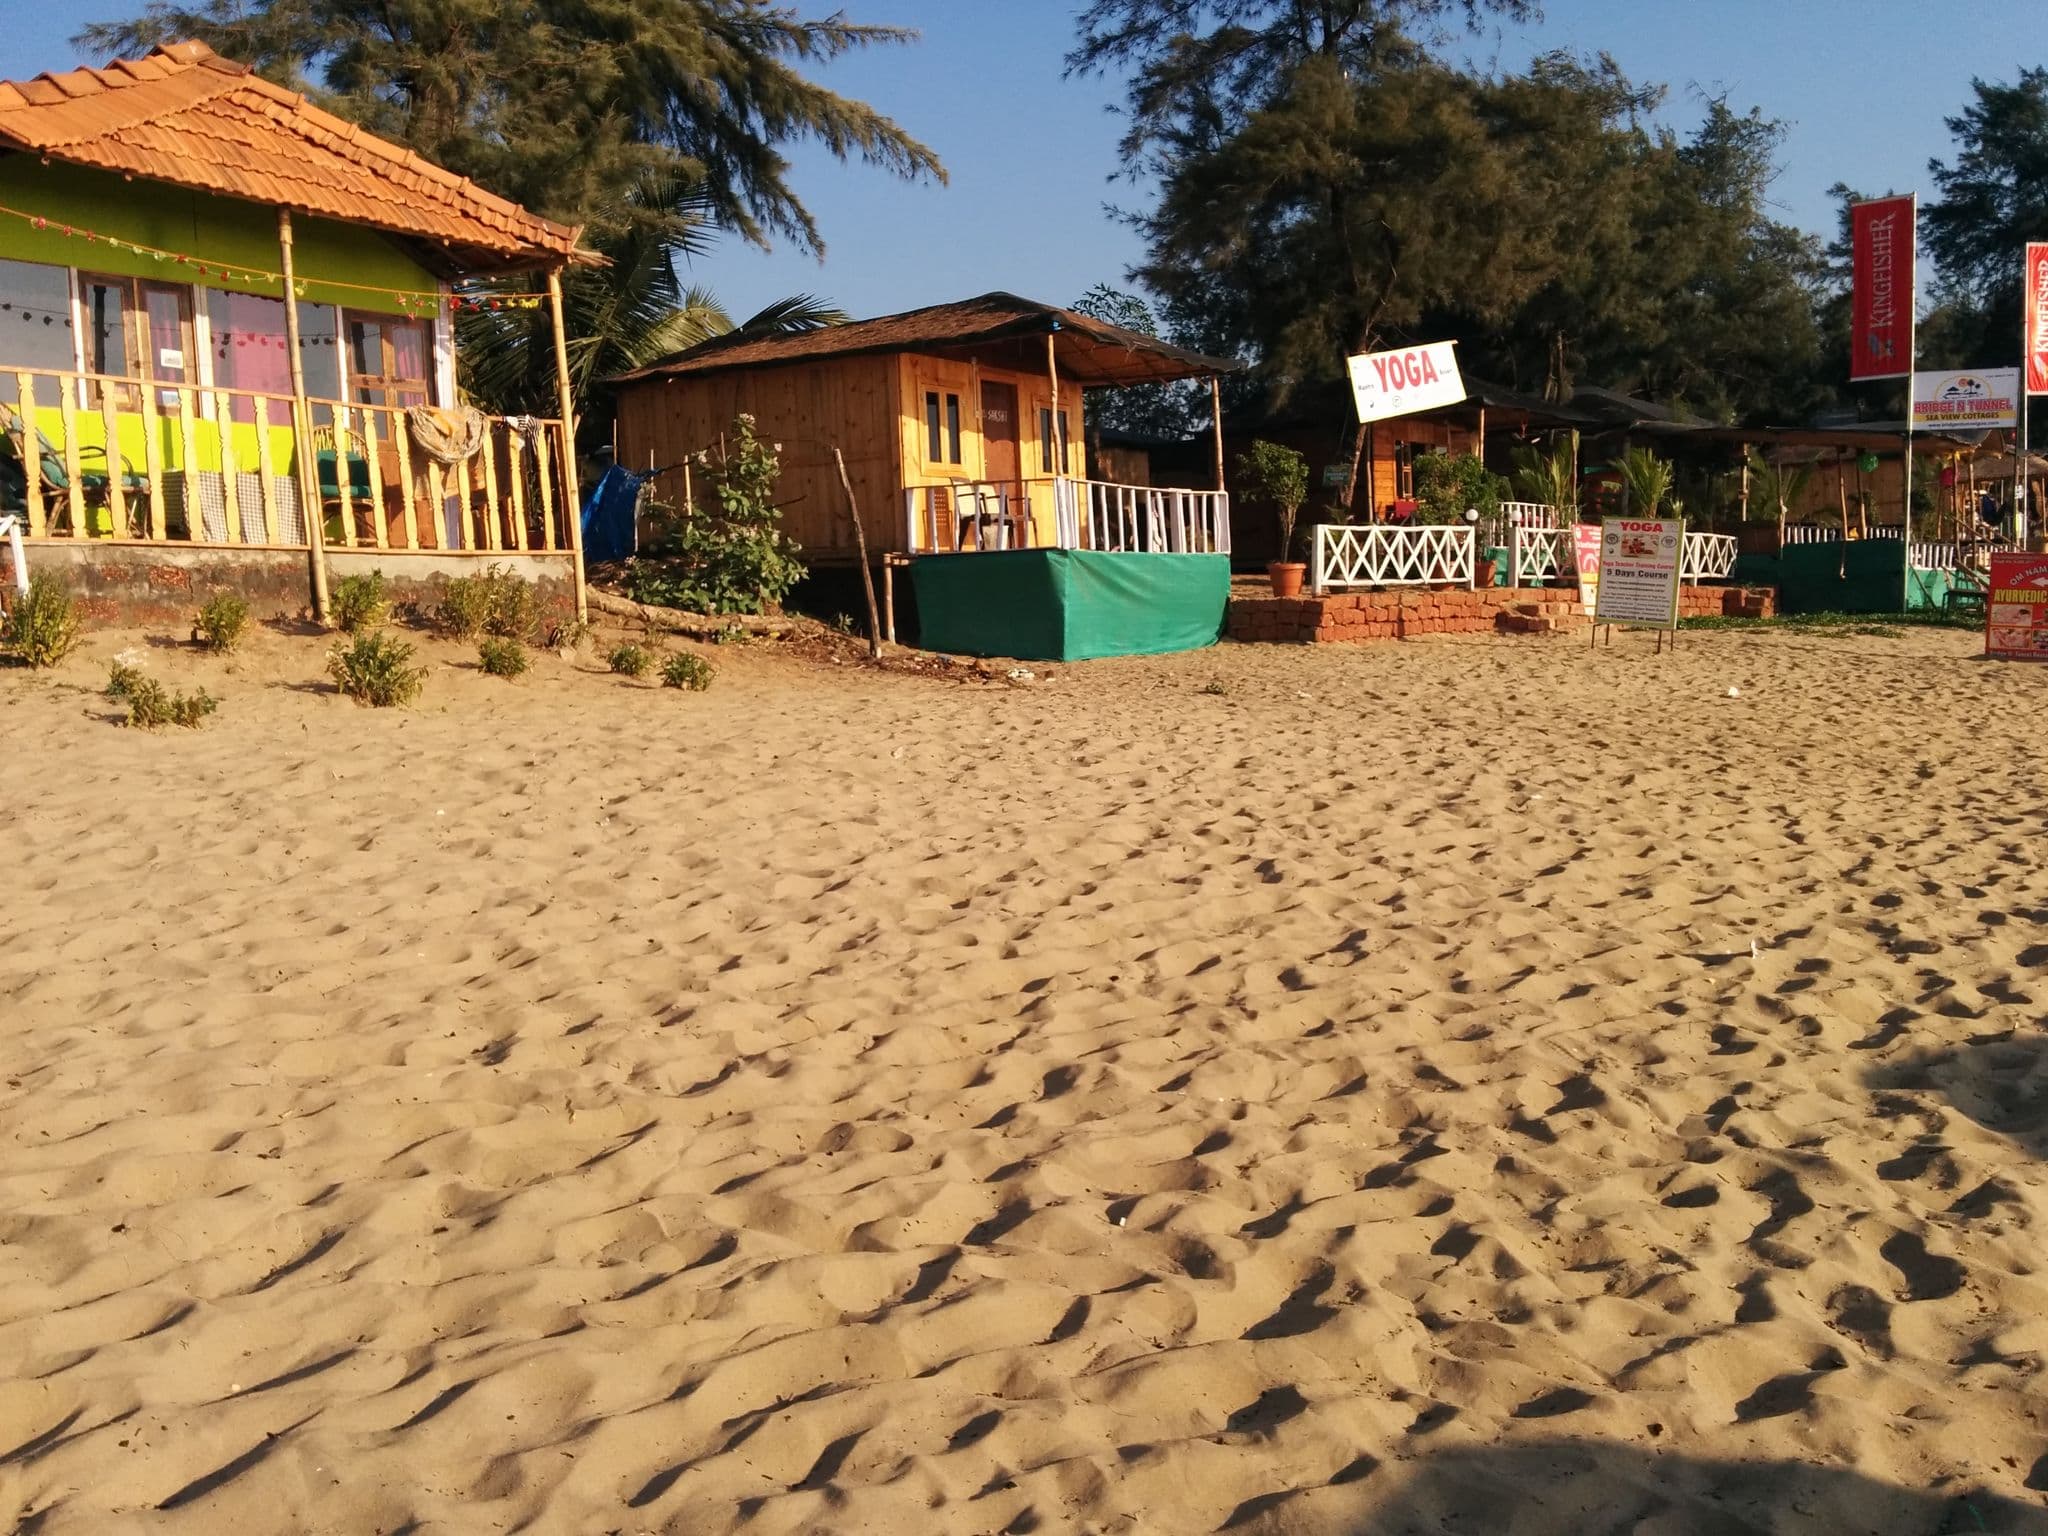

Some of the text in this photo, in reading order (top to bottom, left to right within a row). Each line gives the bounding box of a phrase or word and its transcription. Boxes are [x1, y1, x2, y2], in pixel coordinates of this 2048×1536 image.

[1869, 211, 1897, 328] KINGFISHER
[1372, 350, 1440, 393] YOGA
[1914, 398, 2013, 414] BRIDGE N TUNNEL
[1963, 412, 2000, 420] COTTAGES
[1620, 521, 1664, 533] YOGA
[1606, 568, 1669, 580] 5 Days Course
[2010, 572, 2025, 586] OM
[1994, 589, 2048, 603] AYURVEDIC
